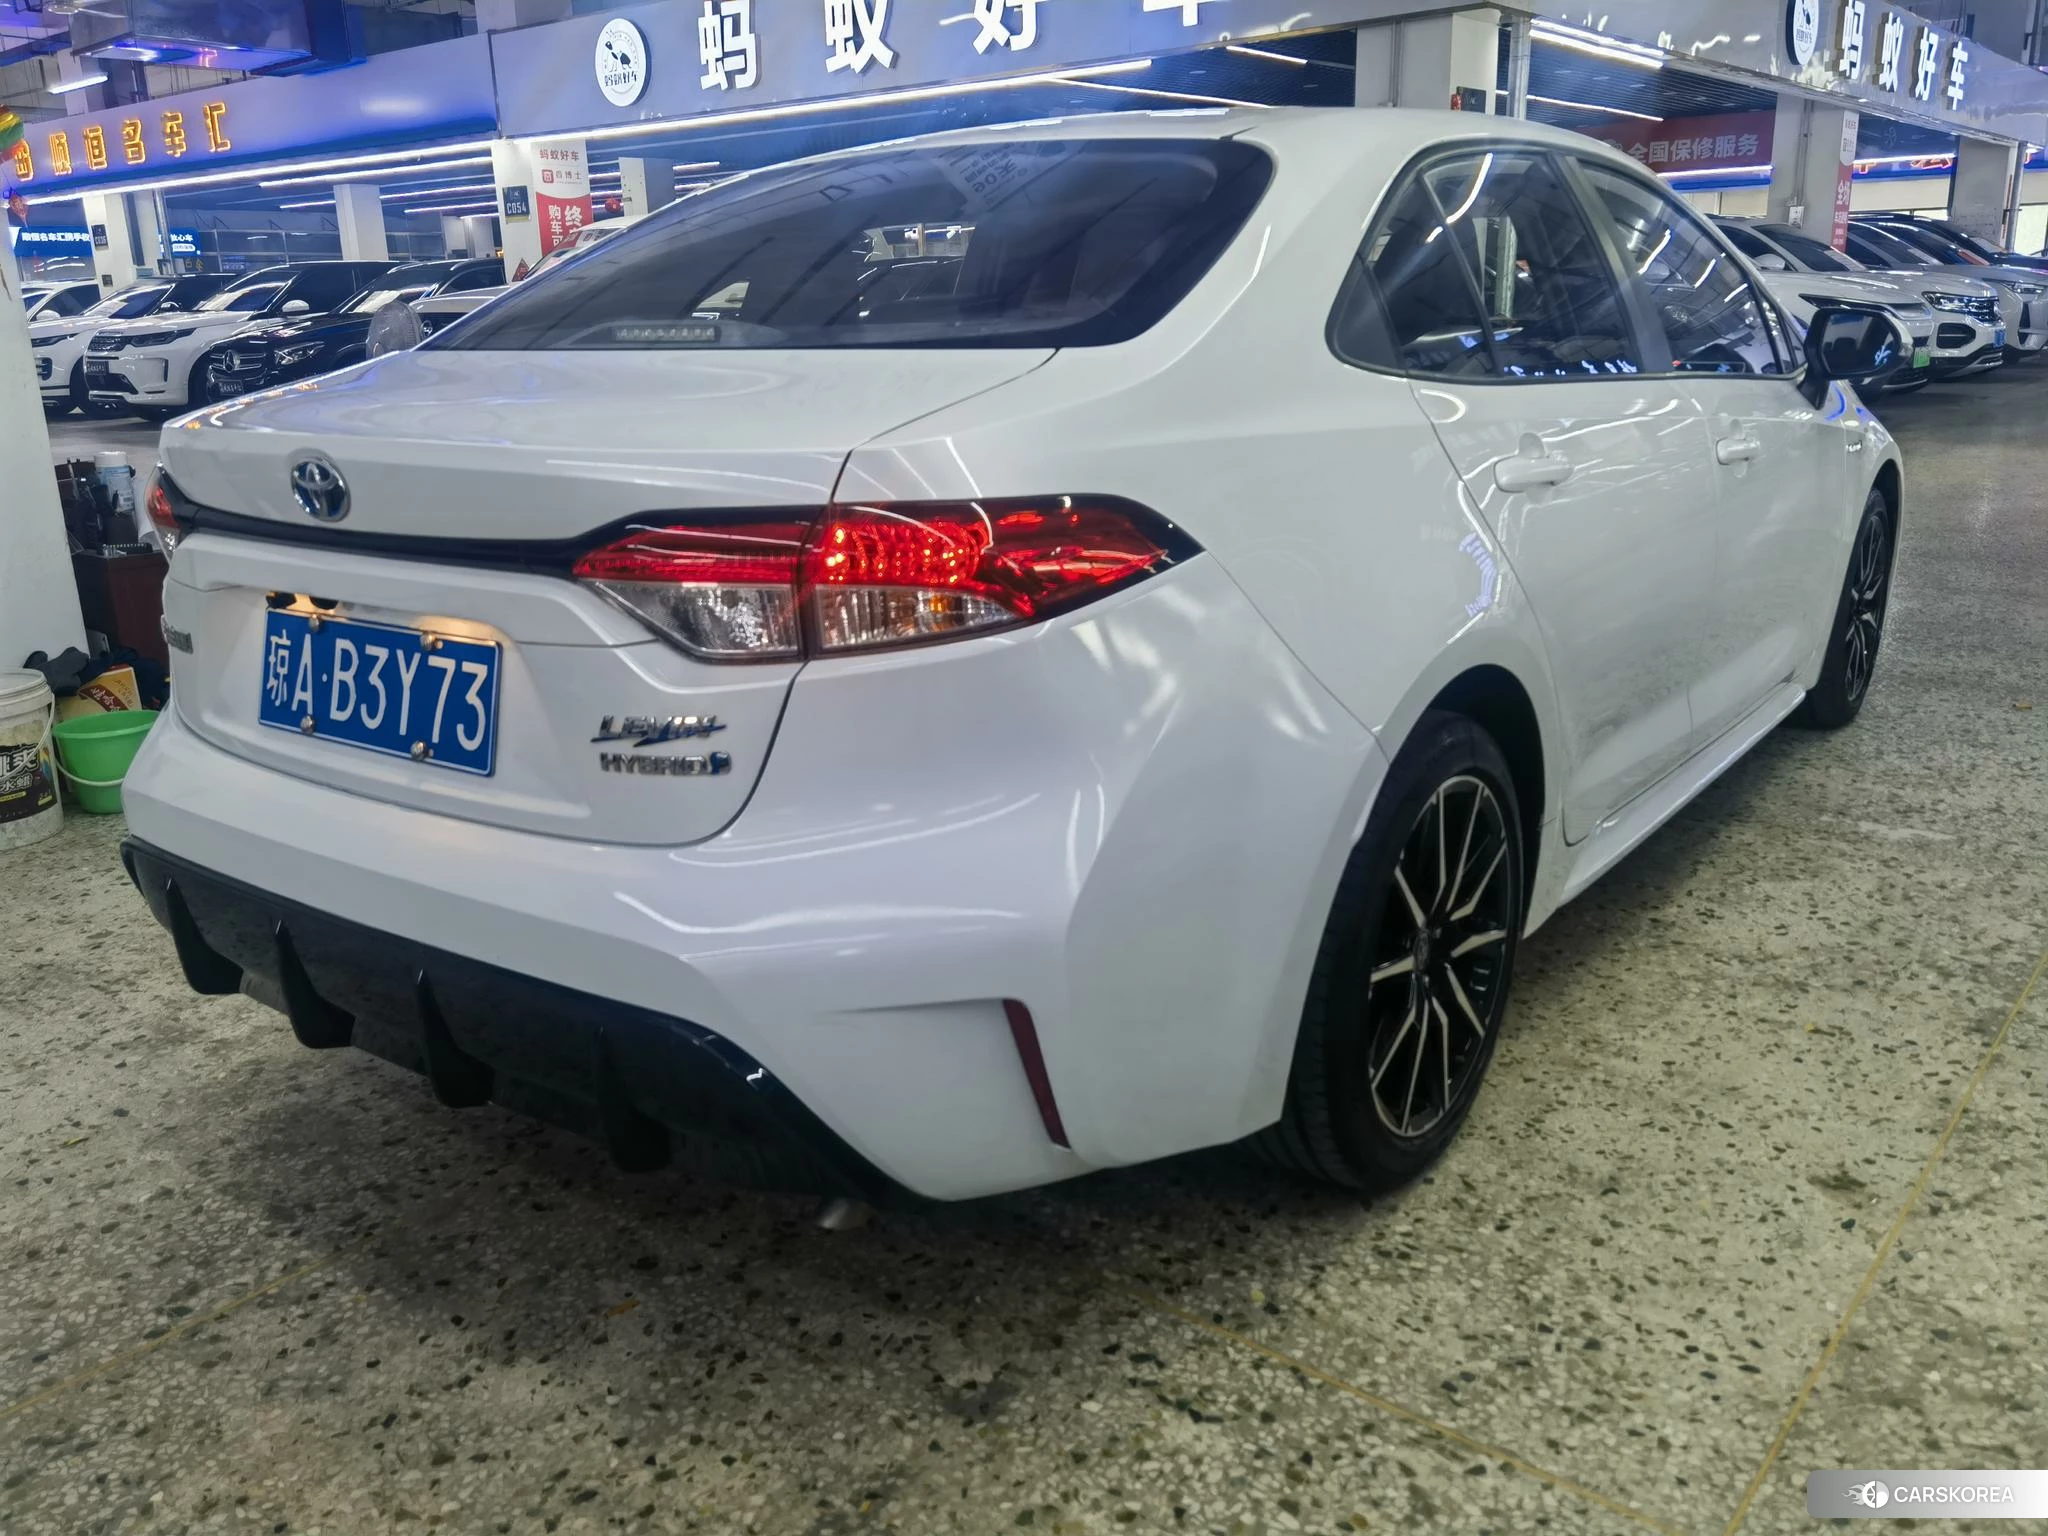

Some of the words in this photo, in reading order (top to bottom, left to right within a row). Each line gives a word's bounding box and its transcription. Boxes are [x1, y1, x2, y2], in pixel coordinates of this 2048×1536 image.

[1839, 0, 1968, 110] 蚂蚁好车
[540, 149, 580, 162] 蚂蚁好车
[1628, 133, 1759, 164] 全国保修服务
[506, 201, 528, 215] C054
[564, 205, 583, 234] 终
